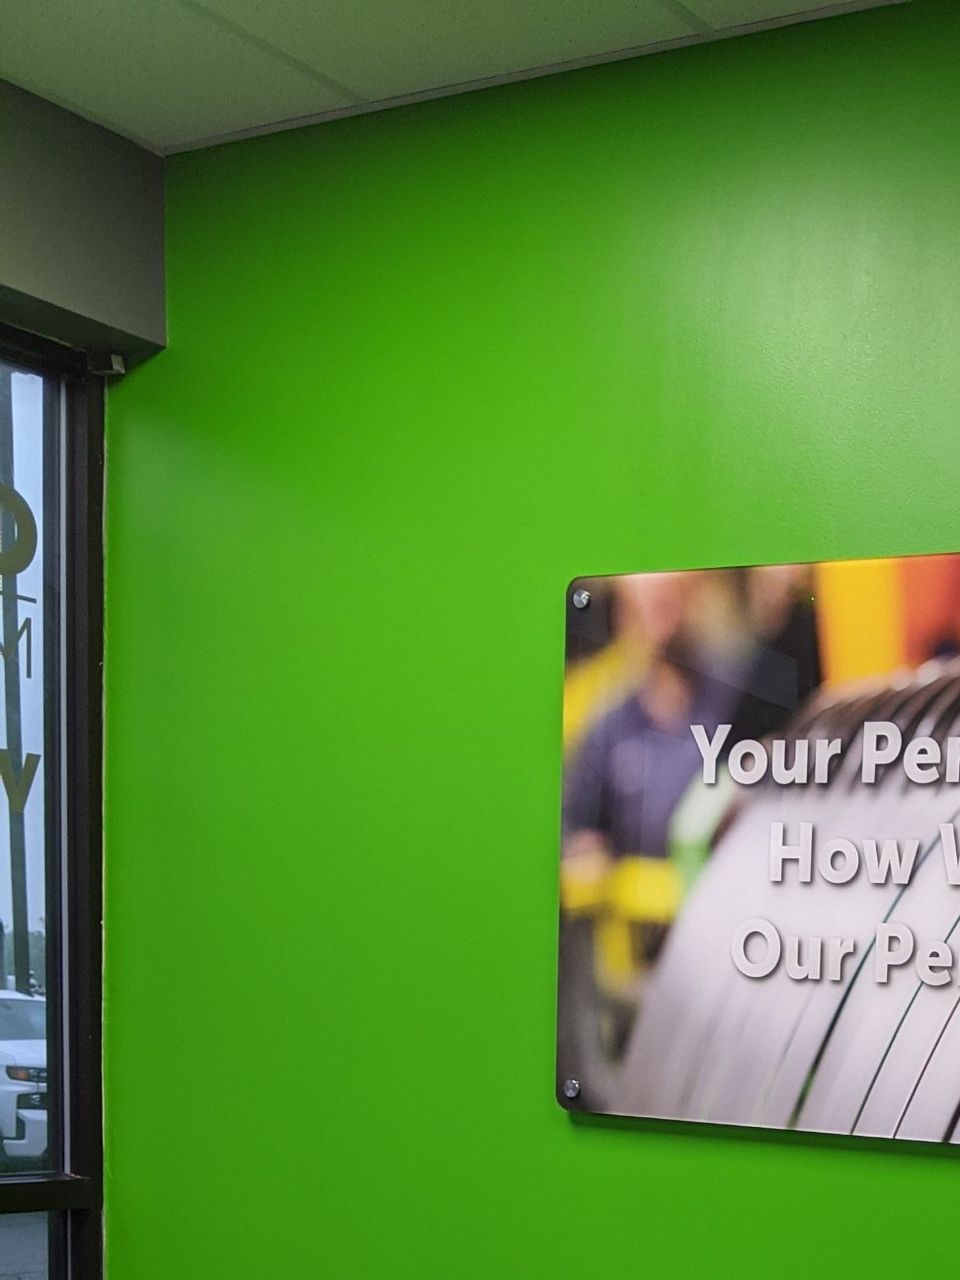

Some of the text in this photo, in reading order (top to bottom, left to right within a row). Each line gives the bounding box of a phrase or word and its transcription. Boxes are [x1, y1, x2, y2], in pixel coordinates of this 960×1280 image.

[690, 723, 841, 785] Your
[768, 822, 919, 884] How
[731, 917, 854, 981] Our
